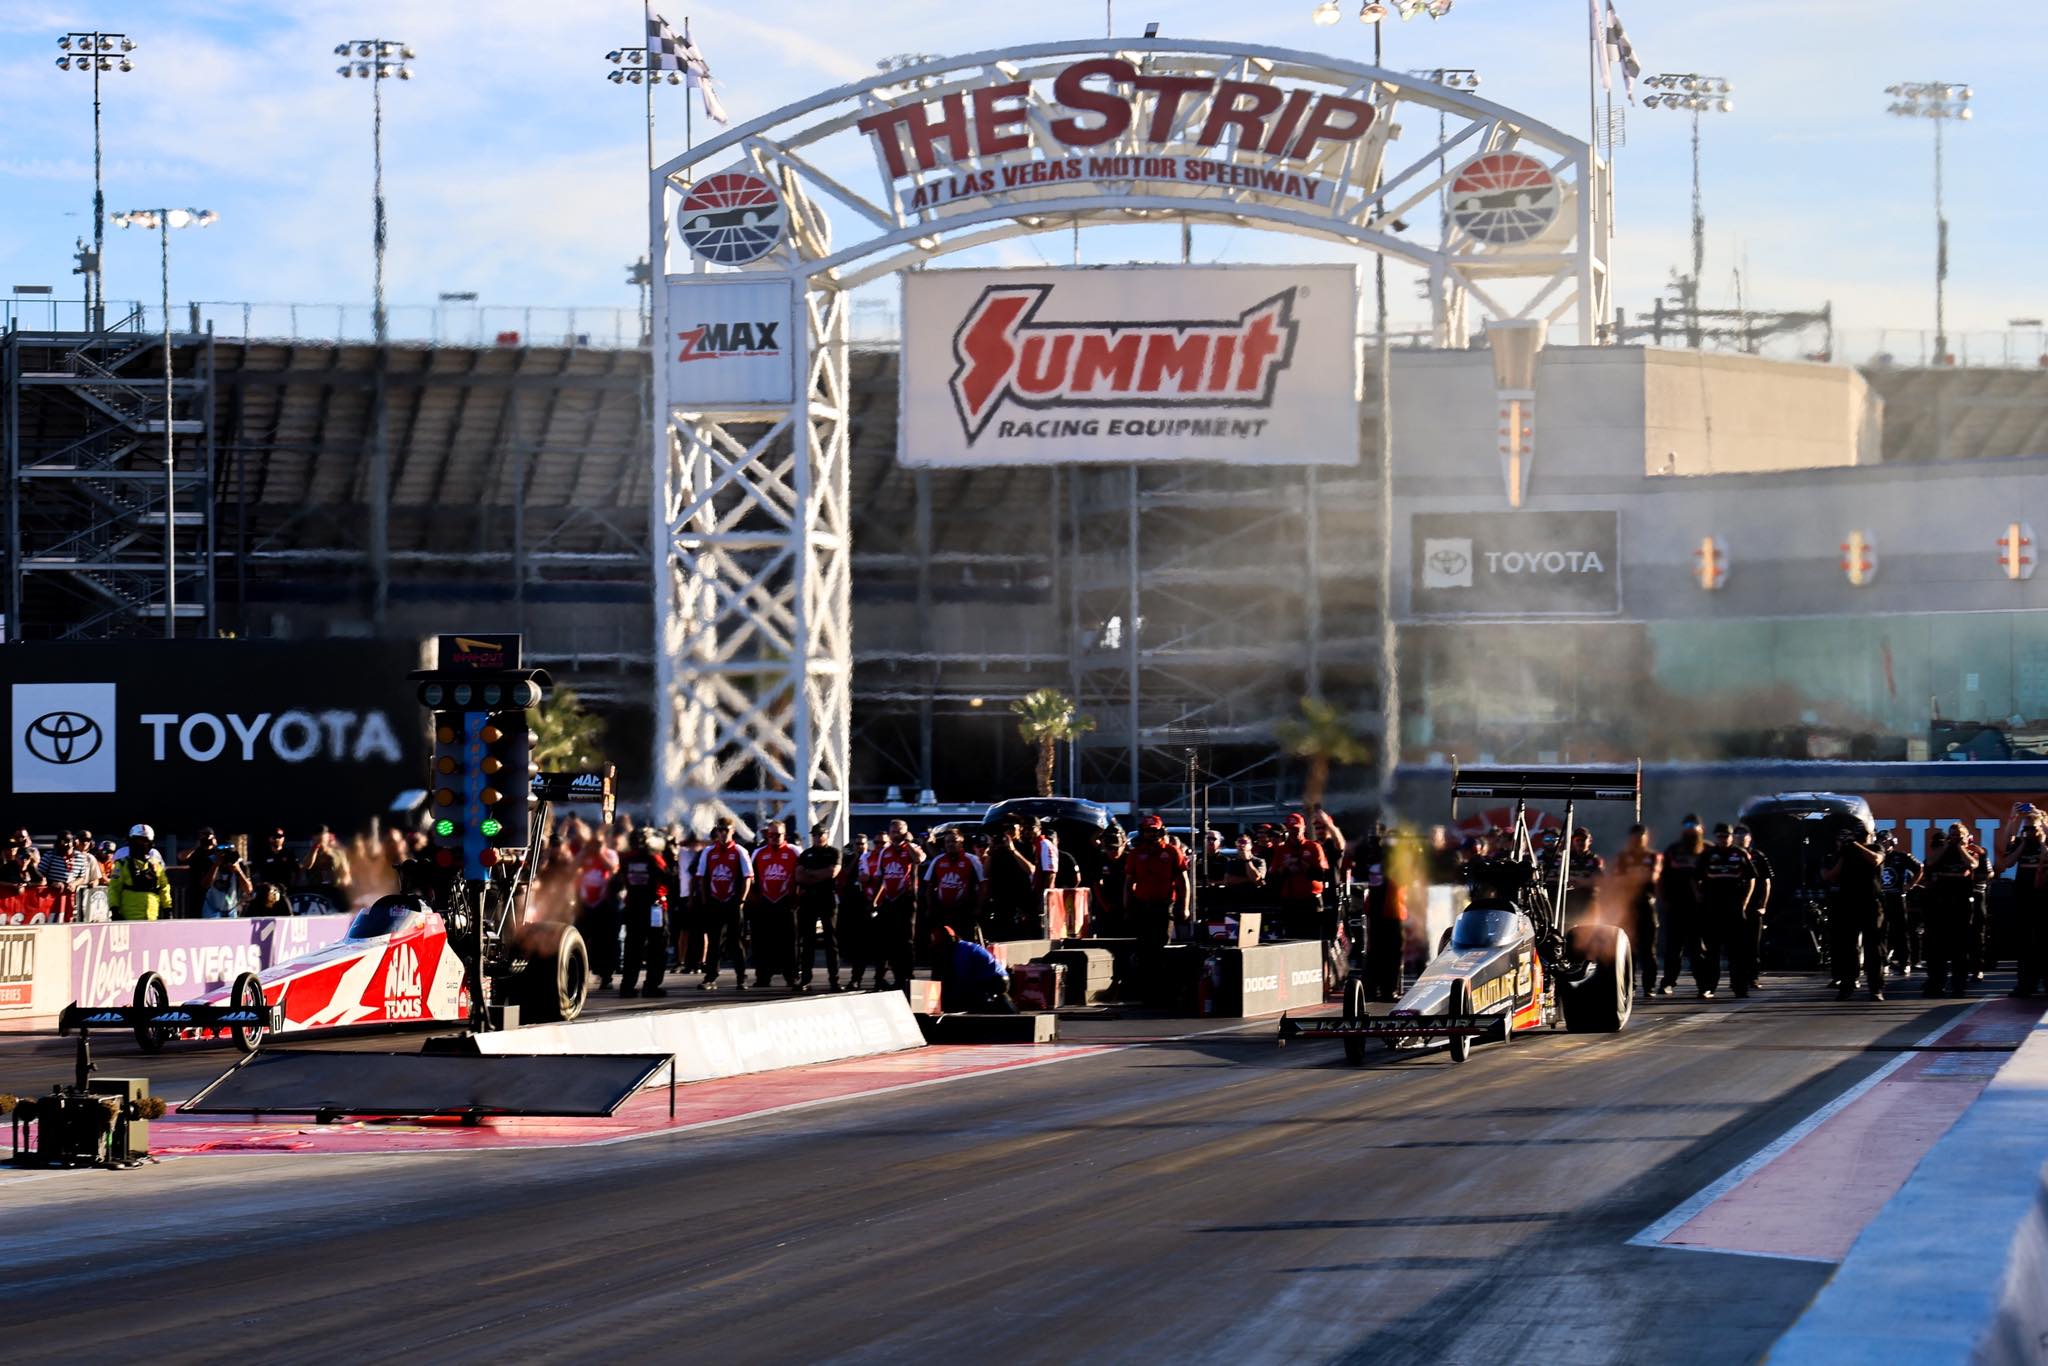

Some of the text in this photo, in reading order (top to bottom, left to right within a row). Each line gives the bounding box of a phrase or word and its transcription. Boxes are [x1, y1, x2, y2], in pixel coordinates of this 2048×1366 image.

[857, 58, 1376, 179] THE STRIP
[911, 156, 1322, 208] AT LAS VEGAS MOTOR SPEEDWAY
[998, 418, 1269, 439] RACING EQUIPMENT
[1484, 551, 1605, 574] TOYOTA
[140, 710, 403, 763] TOYOTA
[142, 943, 262, 986] LAS VEGAS
[1243, 975, 1278, 993] DODGE
[1291, 968, 1323, 986] DODGE
[384, 998, 422, 1019] TOOLS
[1319, 1018, 1473, 1031] KALITTA AIR
